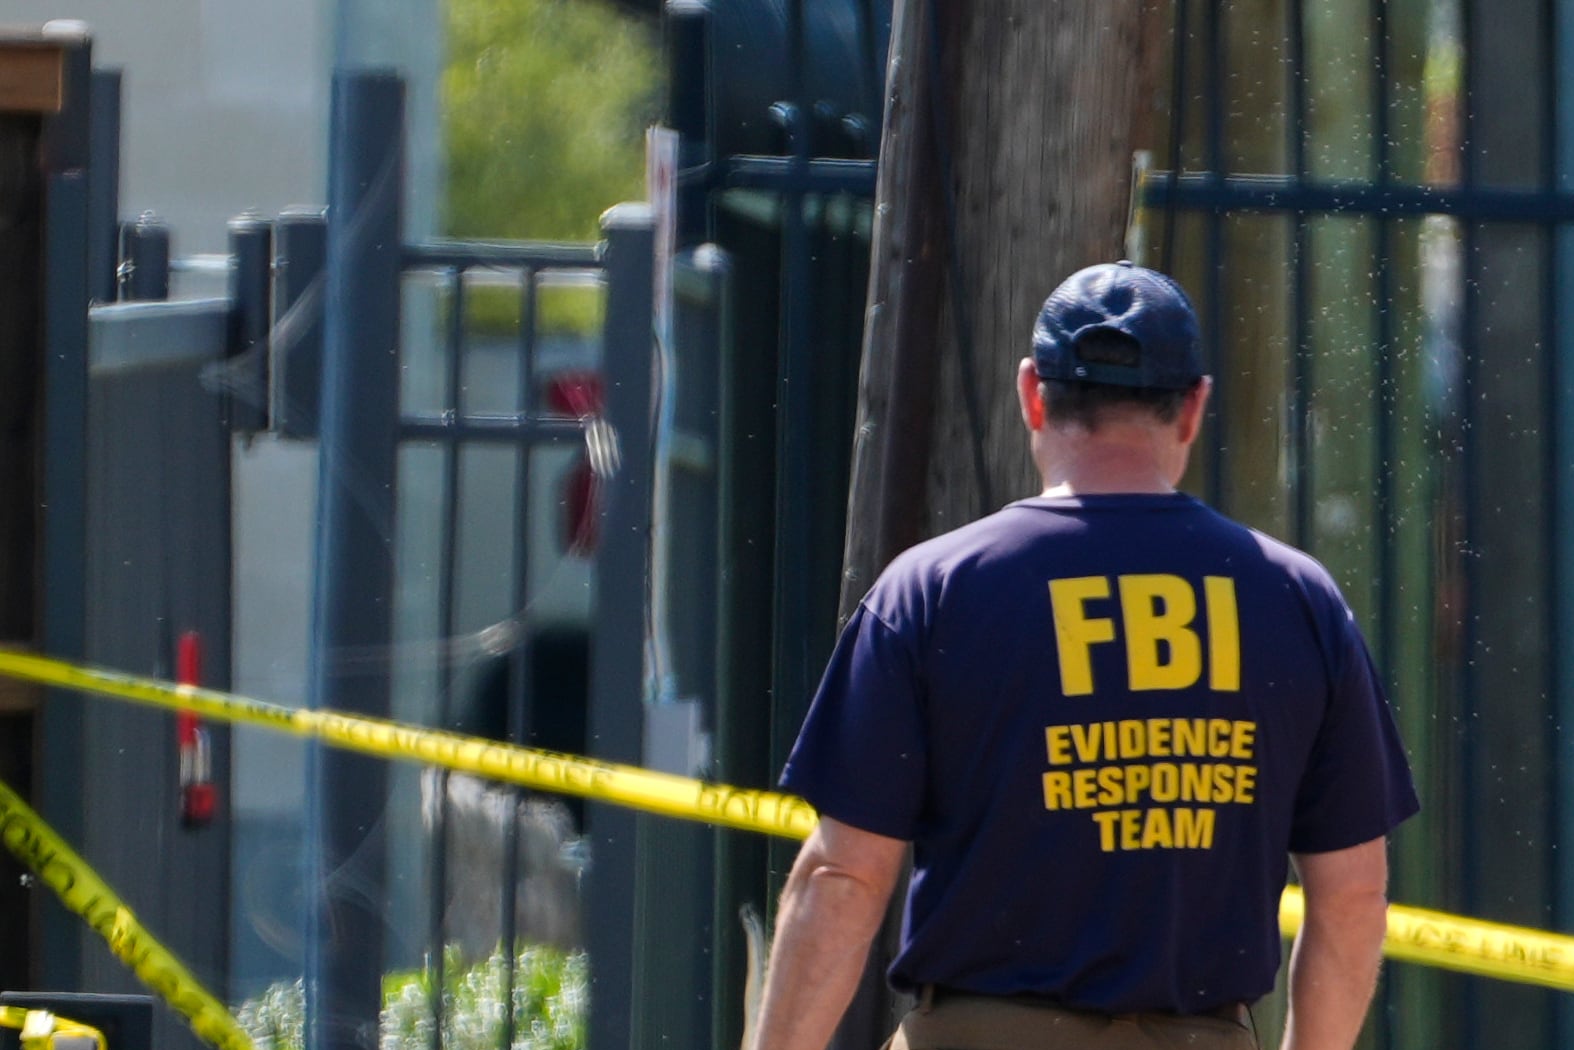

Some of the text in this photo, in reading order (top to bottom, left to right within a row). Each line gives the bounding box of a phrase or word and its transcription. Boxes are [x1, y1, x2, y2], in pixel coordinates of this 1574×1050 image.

[1048, 573, 1240, 696] FBI
[1045, 718, 1256, 765] EVIDENCE
[697, 780, 818, 830] POLIC
[1042, 762, 1257, 810] RESPONSE
[1092, 808, 1216, 852] TEAM
